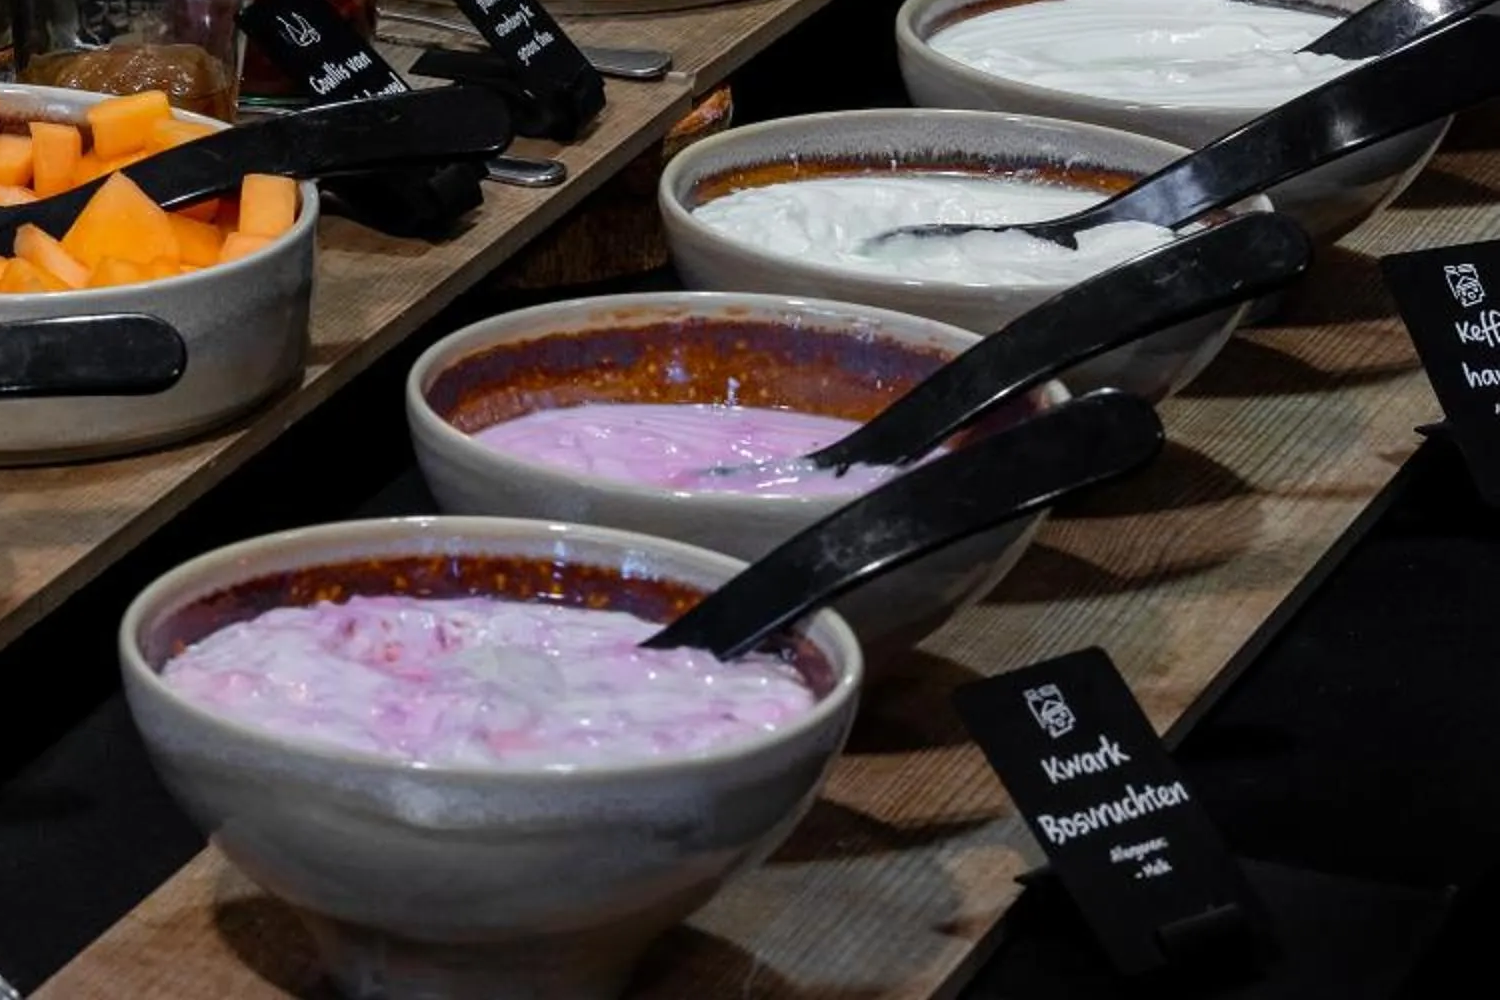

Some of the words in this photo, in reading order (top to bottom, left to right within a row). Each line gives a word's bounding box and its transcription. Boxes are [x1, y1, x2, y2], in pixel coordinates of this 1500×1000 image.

[345, 50, 373, 73] van
[1040, 734, 1131, 784] Kwark
[1037, 781, 1189, 846] Bosvruchten
